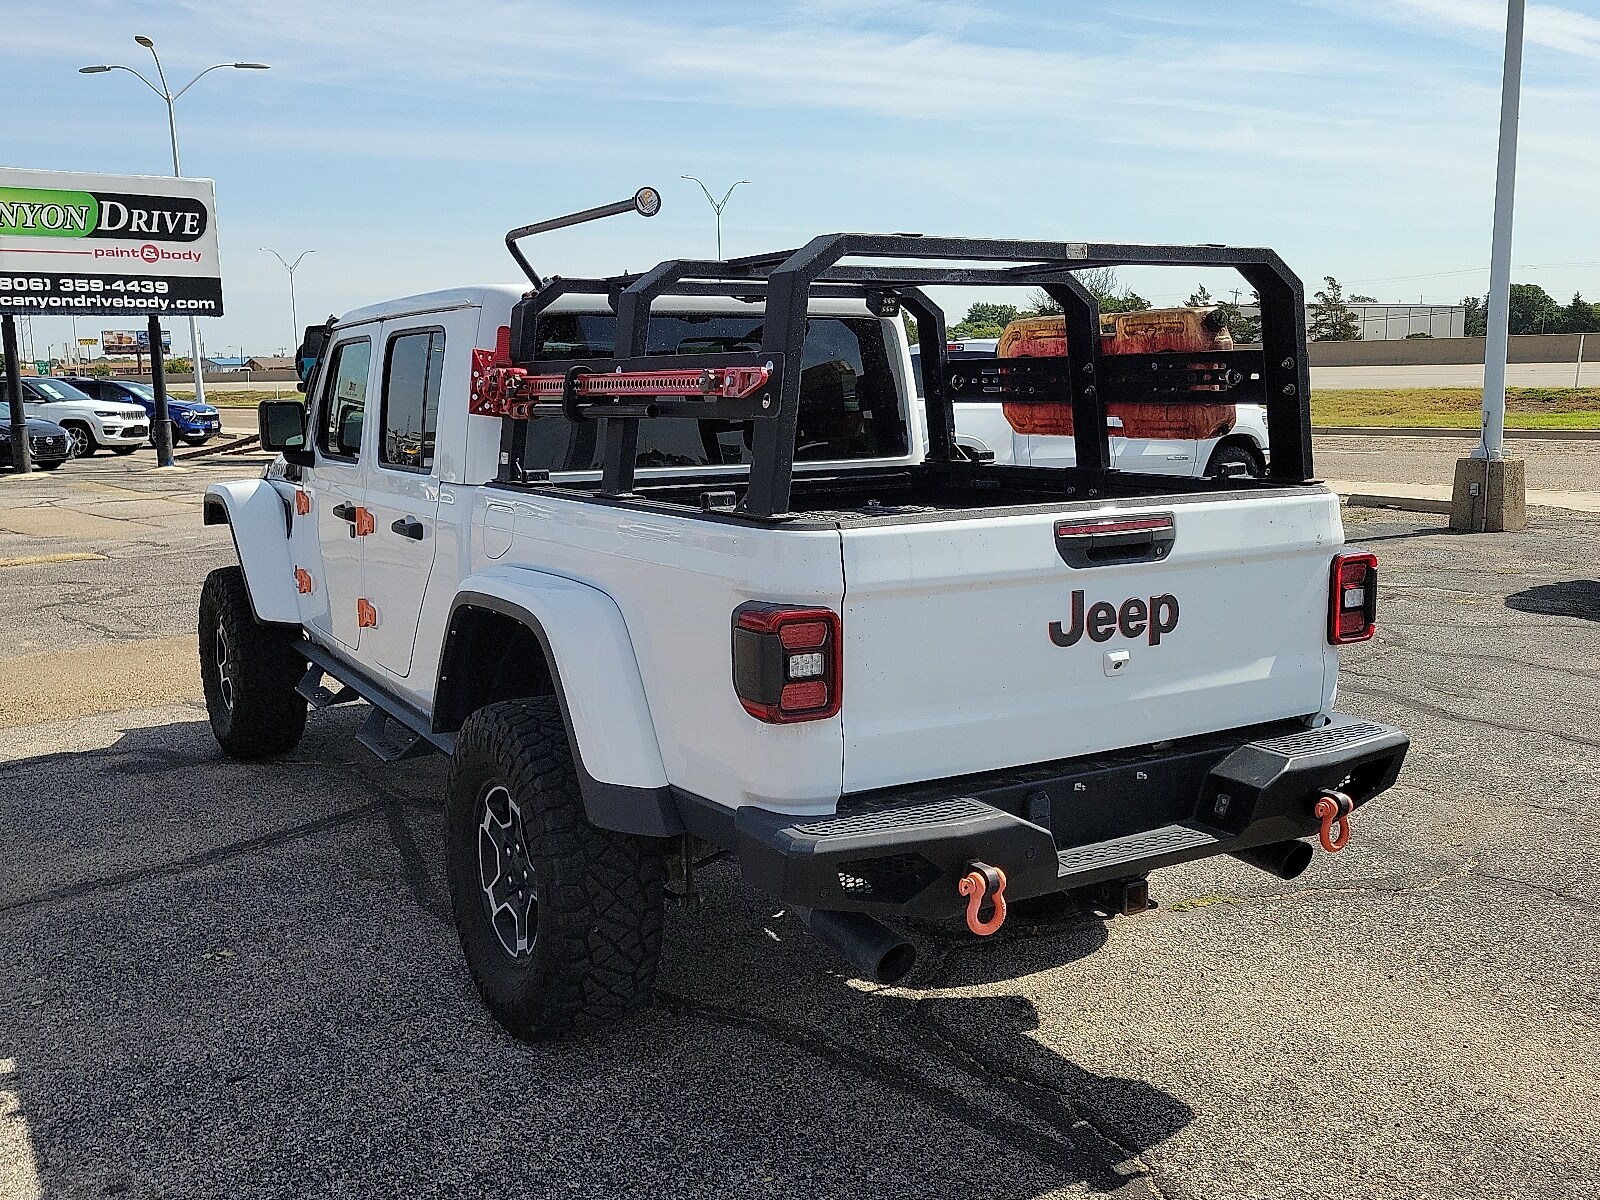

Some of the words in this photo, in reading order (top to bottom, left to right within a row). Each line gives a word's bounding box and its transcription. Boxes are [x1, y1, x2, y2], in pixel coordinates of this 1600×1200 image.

[97, 201, 200, 235] DRIVE
[94, 247, 140, 258] paint
[161, 249, 202, 263] body
[59, 278, 169, 294] 359-4439
[0, 294, 216, 311] canyondrivebody.com
[1049, 589, 1180, 648] Jeep
